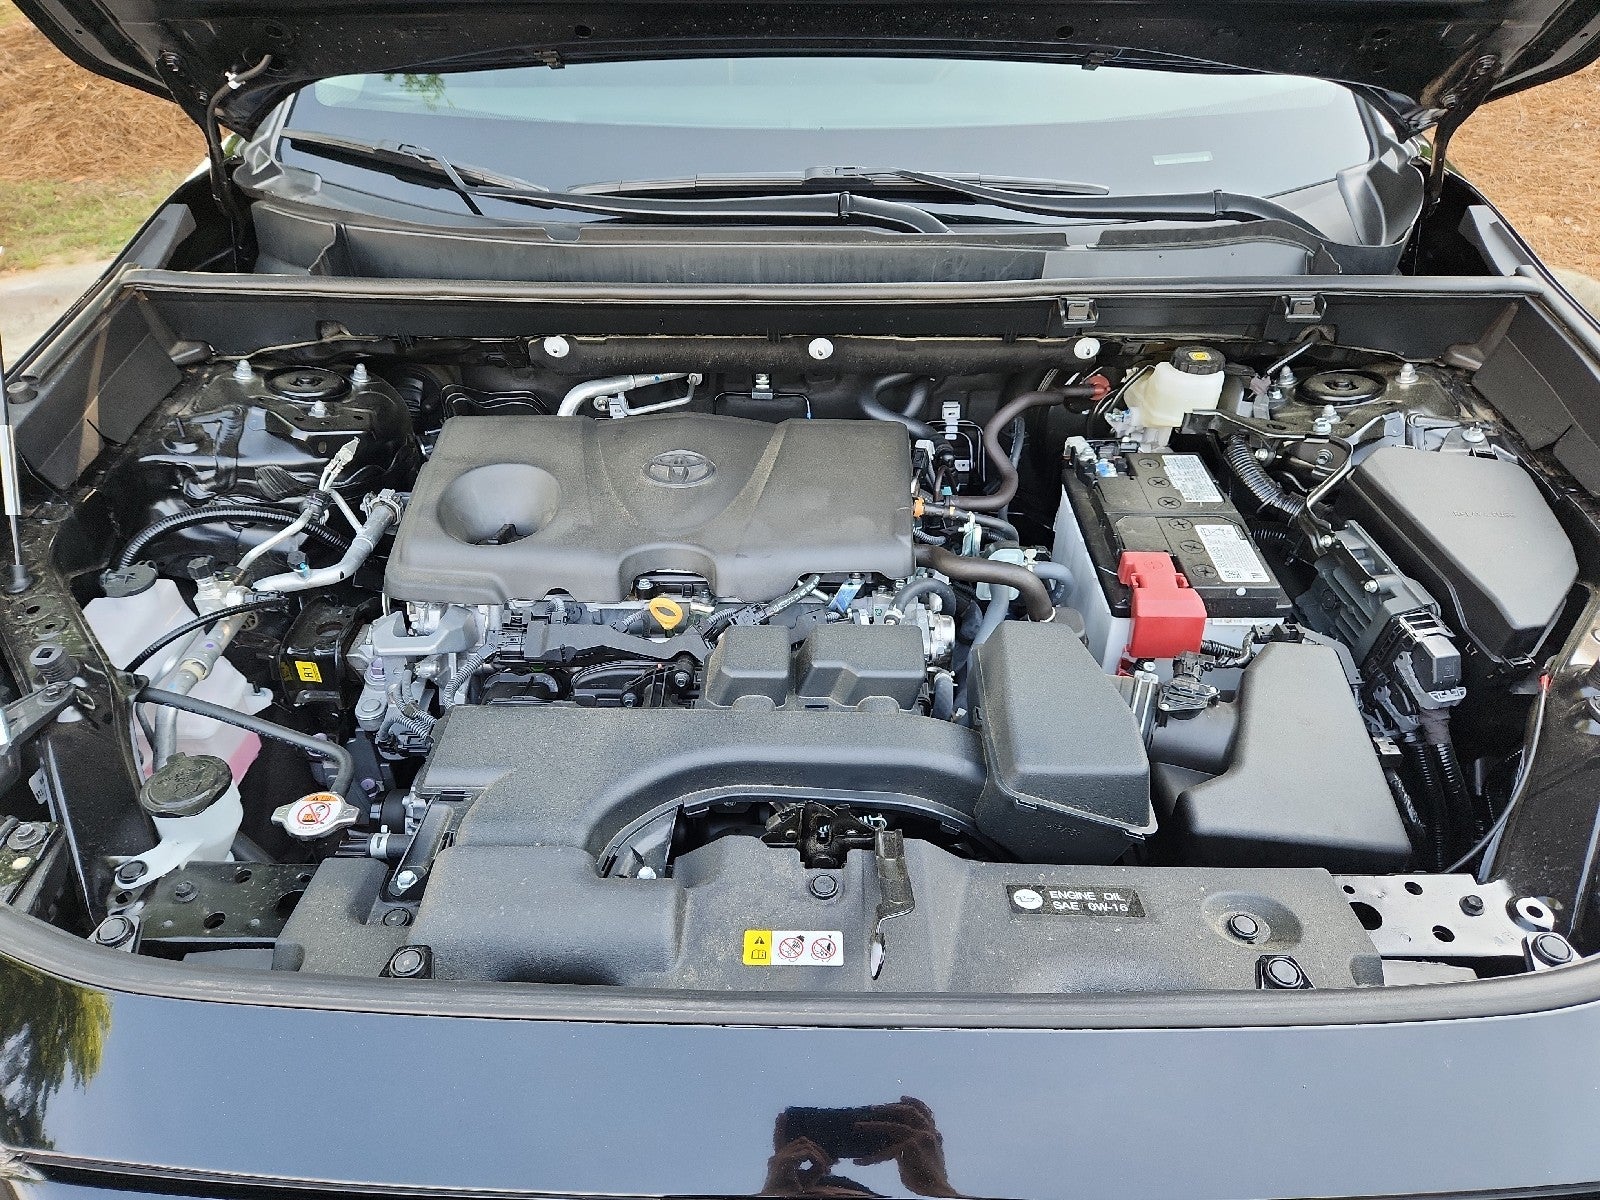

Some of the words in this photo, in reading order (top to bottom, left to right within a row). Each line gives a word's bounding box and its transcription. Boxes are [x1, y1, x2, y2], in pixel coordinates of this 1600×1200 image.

[1049, 890, 1097, 901] ENGINE
[1103, 892, 1126, 901] OIL
[1052, 901, 1080, 910] SAE
[1087, 902, 1129, 912] 0W-16
